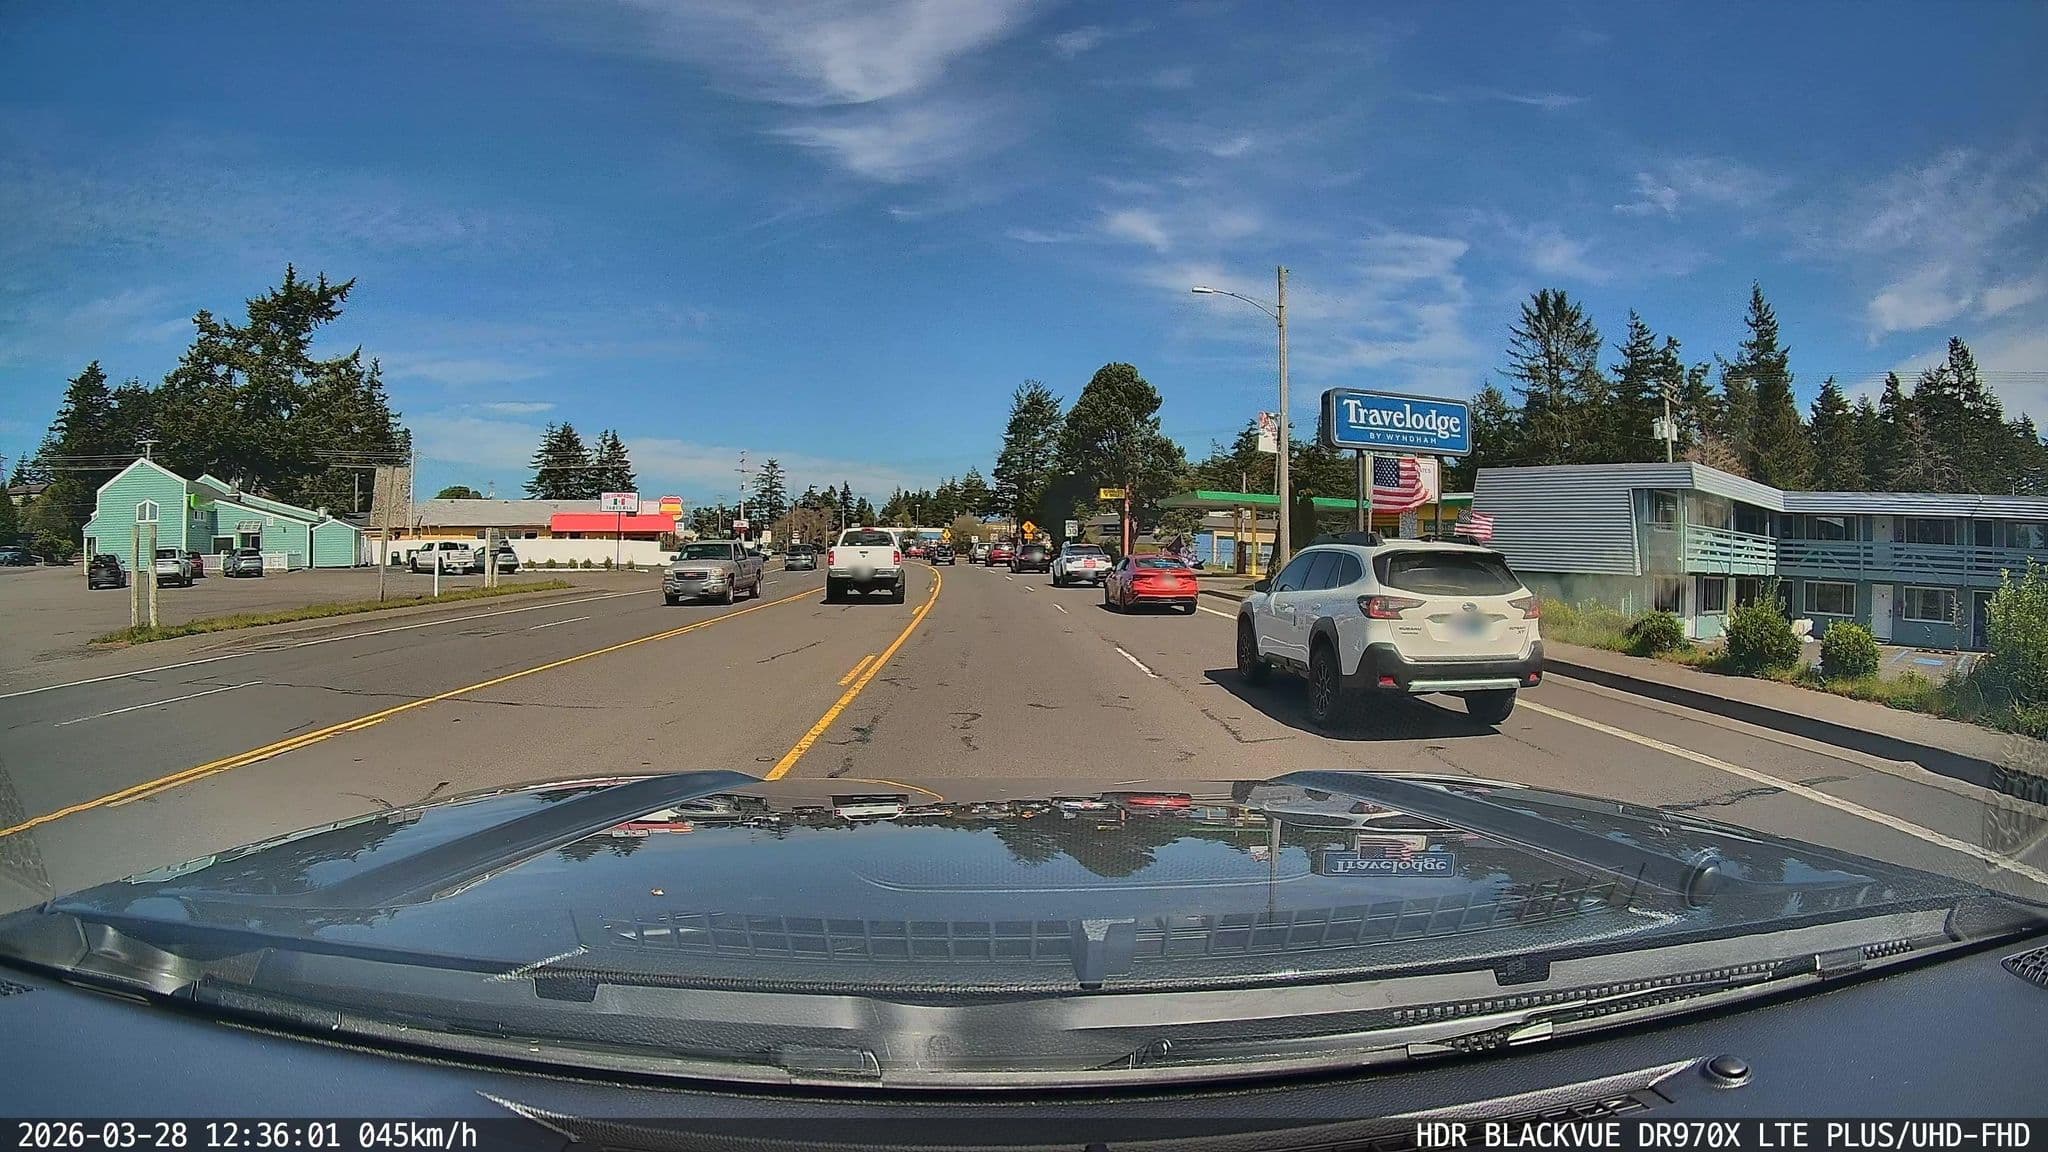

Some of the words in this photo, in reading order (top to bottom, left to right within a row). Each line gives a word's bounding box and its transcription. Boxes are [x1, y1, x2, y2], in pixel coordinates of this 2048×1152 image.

[1342, 398, 1461, 439] Travelodge
[1369, 431, 1381, 440] BY
[1385, 433, 1437, 445] WYNDHAM
